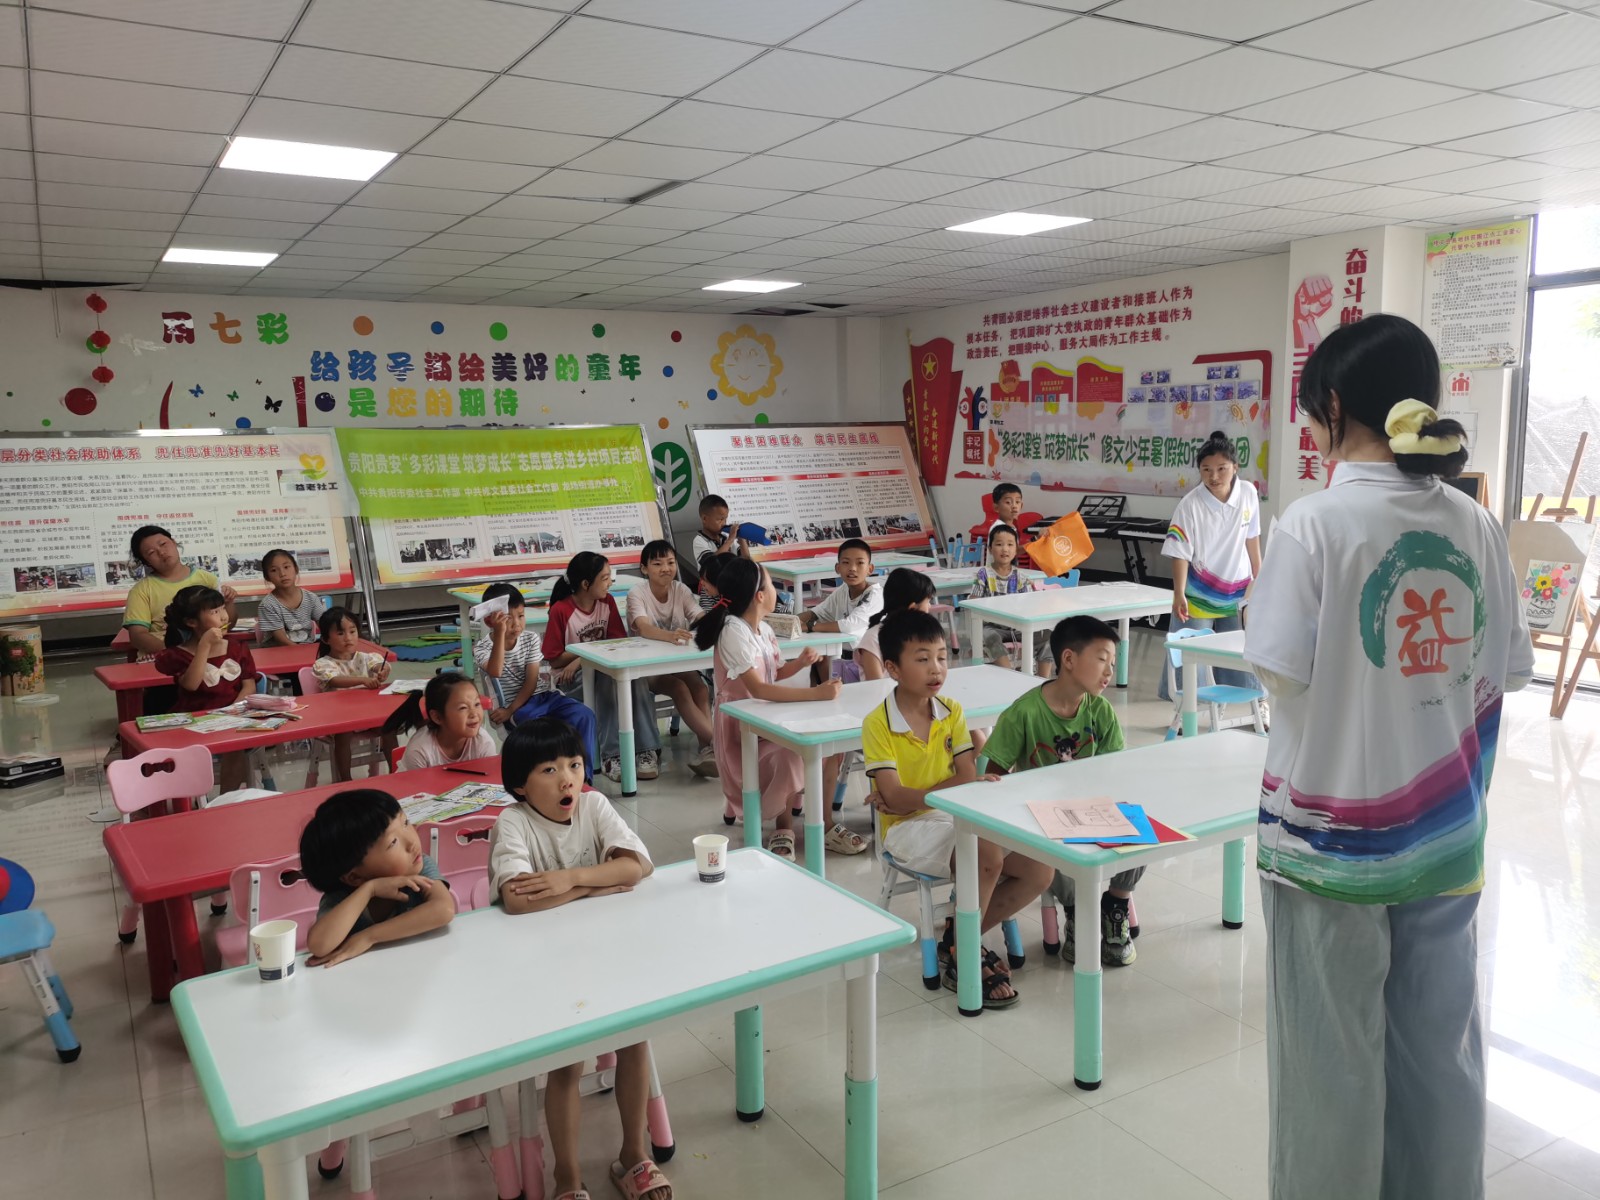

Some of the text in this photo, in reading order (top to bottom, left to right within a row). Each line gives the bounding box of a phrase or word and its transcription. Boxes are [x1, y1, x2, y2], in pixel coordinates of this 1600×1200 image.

[983, 286, 1193, 327] 共青团必须把培养社会主义建设者和接班人作为
[310, 350, 642, 382] 给孩子描绘美好的童年
[347, 387, 519, 418] 是您的期待
[731, 432, 881, 448] 聚焦困难群众 筑牢民生底线
[966, 436, 981, 447] 牢记
[0, 447, 141, 463] 层分类社会救助体系
[966, 448, 981, 460] 嘱托
[1101, 435, 1250, 468] 修文少年暑假知行团
[360, 487, 461, 498] 中共贵阳市委社会工作部
